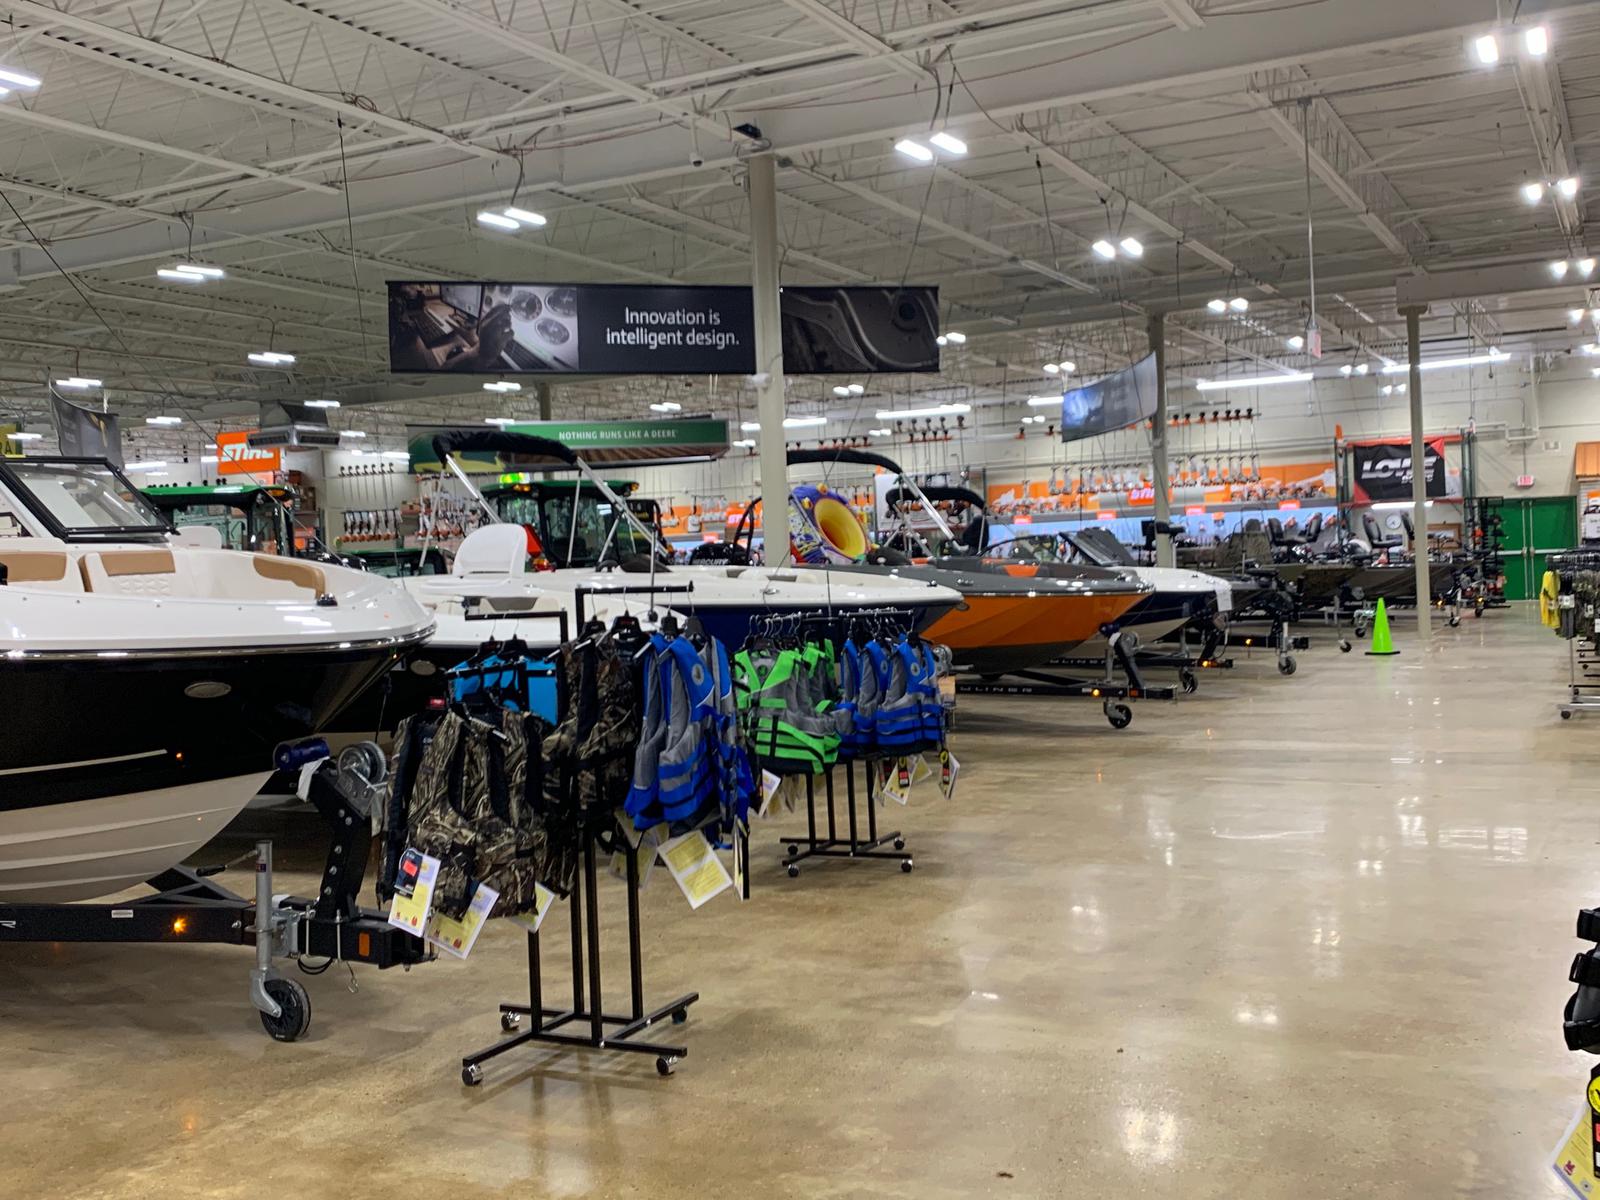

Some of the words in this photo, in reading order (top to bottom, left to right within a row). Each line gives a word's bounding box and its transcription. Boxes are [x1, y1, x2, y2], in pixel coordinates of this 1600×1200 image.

[624, 306, 706, 325] Innovation
[709, 308, 721, 326] is
[606, 326, 683, 350] intelligent
[686, 327, 740, 350] design.
[559, 431, 598, 440] NOTHING
[600, 431, 621, 439] RUNS
[624, 430, 641, 439] LIKE
[644, 430, 650, 438] A
[651, 429, 677, 438] DEERE
